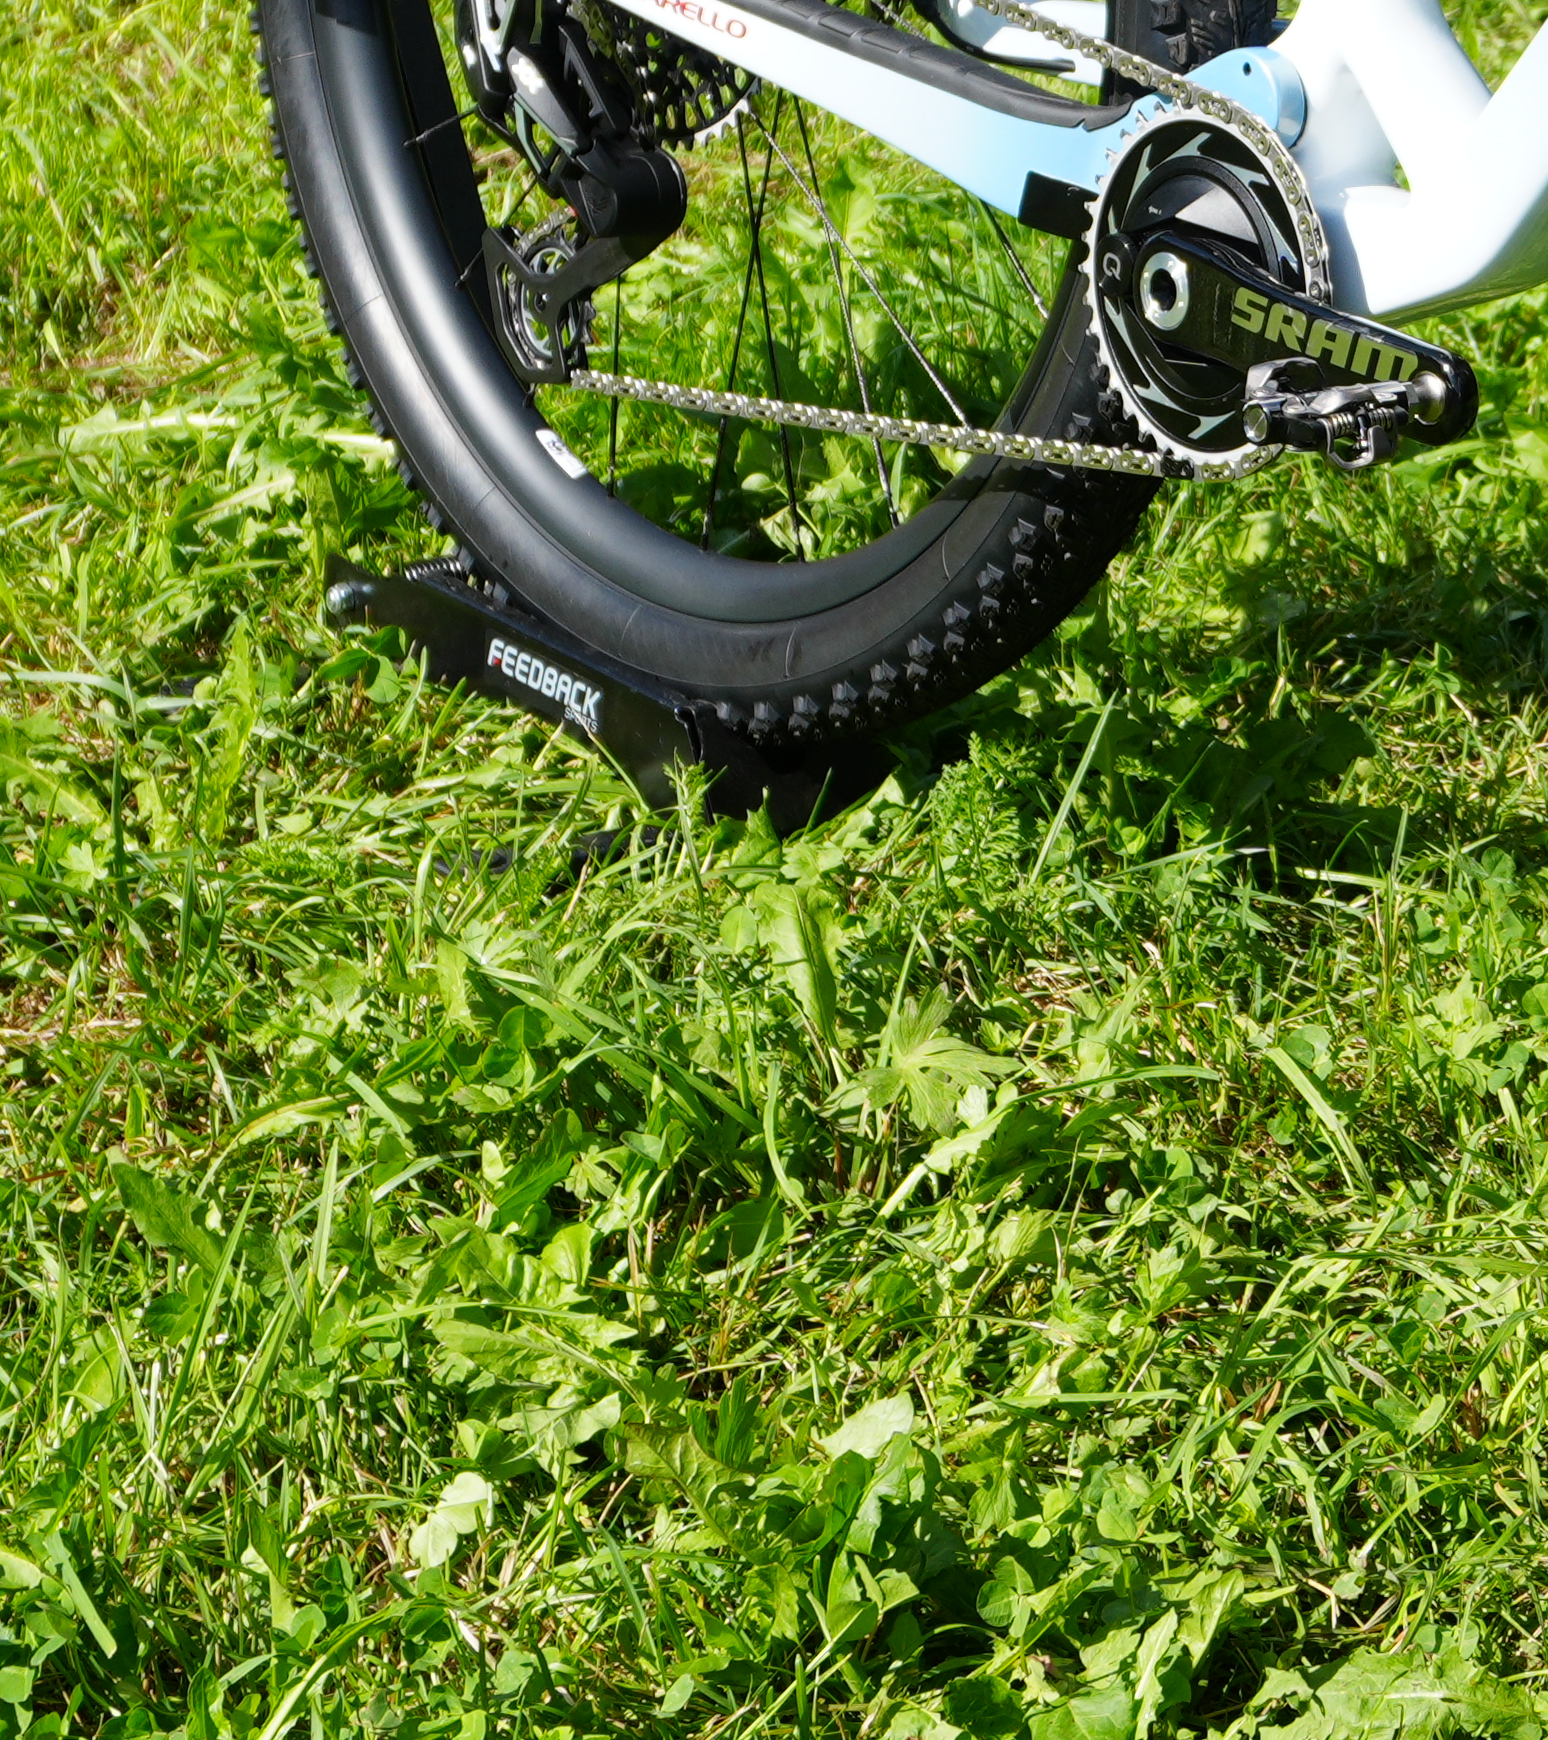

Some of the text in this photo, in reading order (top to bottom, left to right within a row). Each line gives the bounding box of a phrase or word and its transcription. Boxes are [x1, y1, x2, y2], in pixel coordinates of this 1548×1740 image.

[1102, 251, 1121, 281] Q
[1231, 286, 1419, 382] SRAM
[487, 637, 602, 721] FEEDBACK
